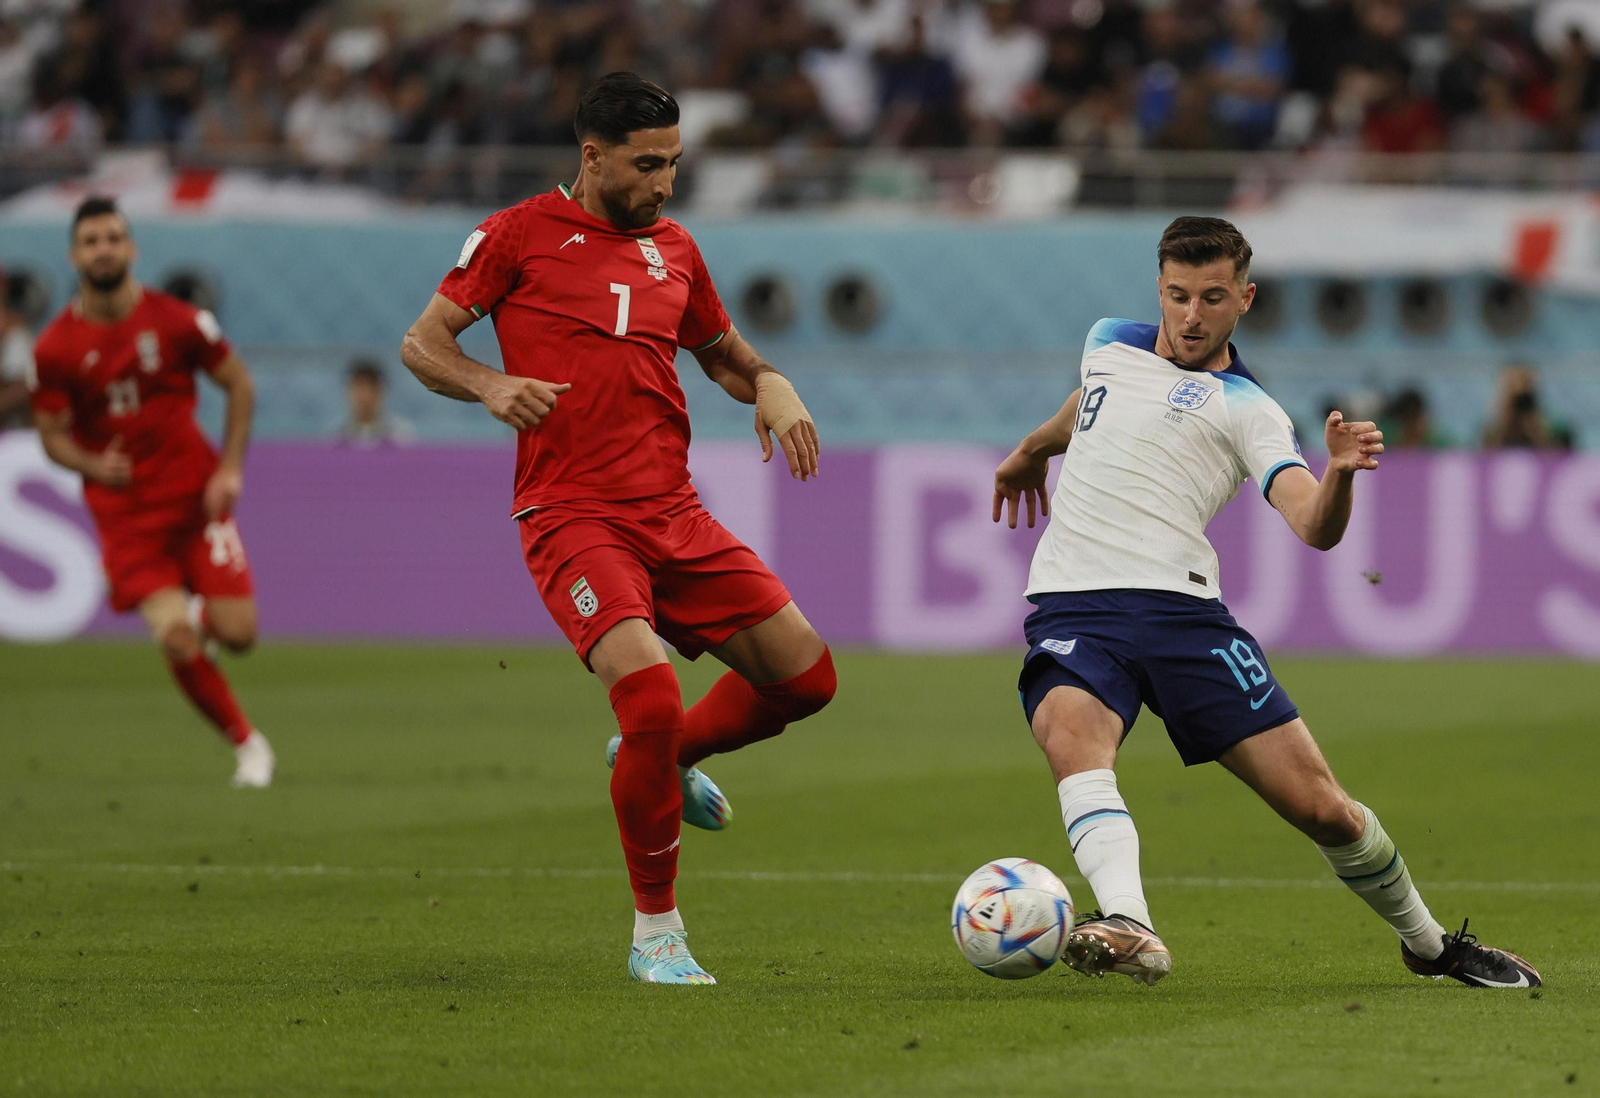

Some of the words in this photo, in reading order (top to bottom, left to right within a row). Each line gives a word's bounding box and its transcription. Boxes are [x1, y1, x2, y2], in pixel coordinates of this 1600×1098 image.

[610, 282, 631, 336] 7
[1073, 385, 1108, 433] 19
[872, 443, 1600, 656] BJU'
[1210, 637, 1268, 692] 19
